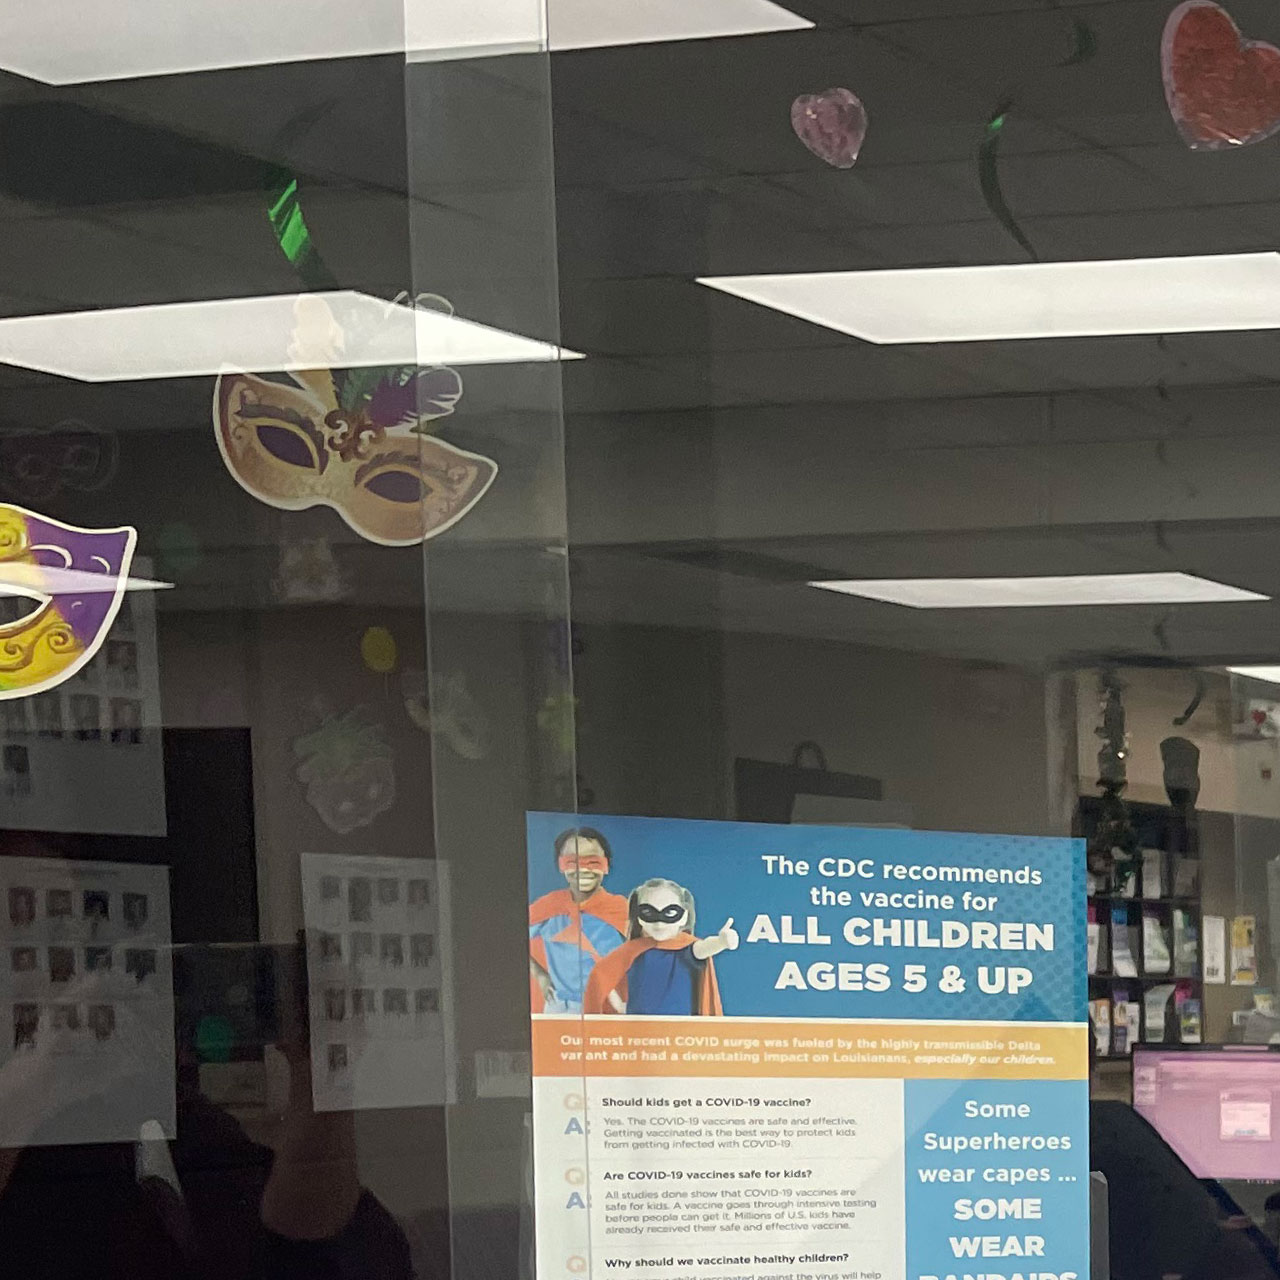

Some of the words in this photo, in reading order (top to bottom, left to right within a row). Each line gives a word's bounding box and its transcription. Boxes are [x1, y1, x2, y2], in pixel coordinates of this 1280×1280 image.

[761, 855, 809, 875] The
[818, 857, 874, 878] CDC
[883, 864, 1042, 884] recommends
[809, 885, 851, 906] the
[859, 889, 954, 909] vaccine
[961, 891, 997, 911] for
[746, 914, 831, 944] ALL
[843, 917, 1053, 950] CHILDREN
[774, 961, 891, 991] AGES
[902, 964, 927, 992] 5
[938, 964, 966, 993] &
[977, 966, 1032, 994] UP
[602, 1097, 642, 1106] Should
[645, 1097, 669, 1106] kids
[672, 1098, 691, 1108] get
[705, 1097, 760, 1106] COVID-19
[763, 1097, 811, 1106] vaccine?
[964, 1100, 1030, 1117] Some
[924, 1131, 1071, 1153] Superheroes
[603, 1171, 624, 1180] Are
[627, 1170, 683, 1180] COVID-19
[686, 1170, 735, 1179] vaccines
[738, 1169, 761, 1178] safe
[764, 1169, 780, 1178] for
[783, 1169, 812, 1178] kids?
[917, 1168, 975, 1182] wear
[982, 1167, 1050, 1185] capes
[953, 1198, 1041, 1220] SOME
[948, 1235, 1044, 1257] WEAR
[604, 1258, 631, 1268] Why
[634, 1257, 673, 1266] should
[696, 1255, 750, 1265] vaccinate
[753, 1254, 795, 1264] healthy
[798, 1253, 848, 1262] children?
